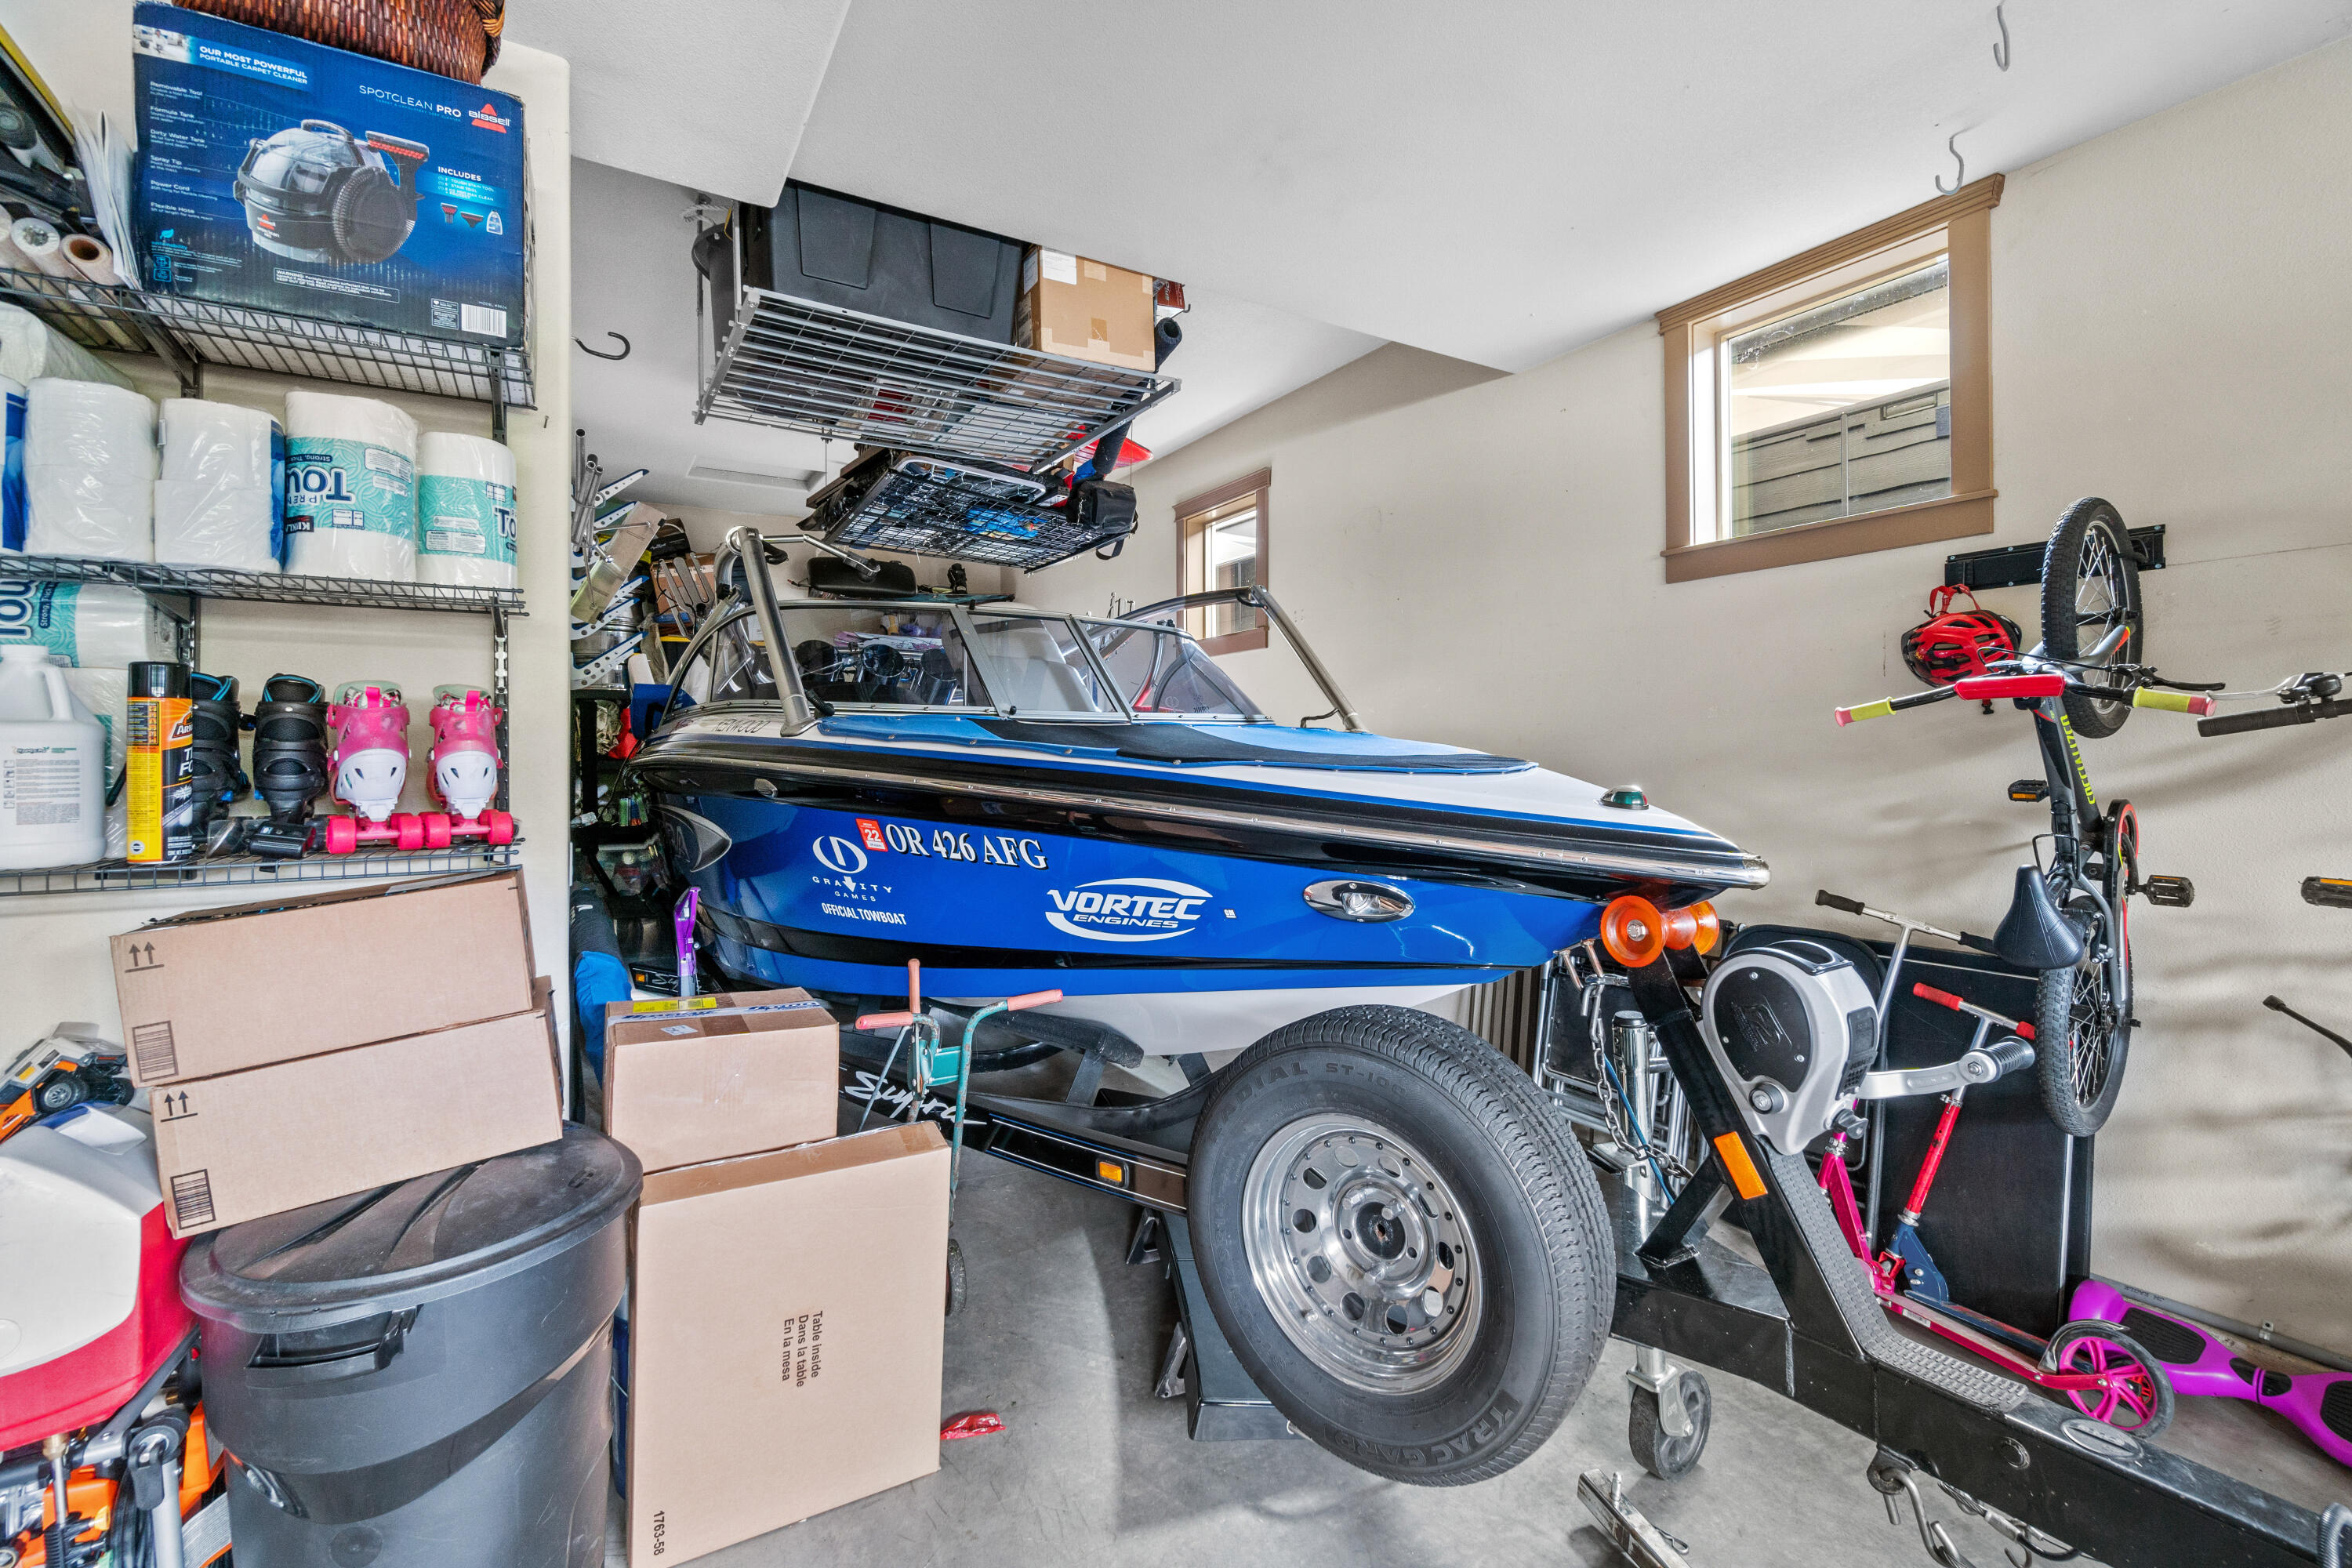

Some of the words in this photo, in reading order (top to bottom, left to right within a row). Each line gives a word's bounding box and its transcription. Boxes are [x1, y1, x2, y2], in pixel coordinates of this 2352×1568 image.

[199, 45, 222, 57] OUR
[223, 51, 252, 64] MOST
[254, 57, 307, 79] POWERFUL
[199, 53, 239, 67] PORTABLE
[241, 61, 271, 75] CARPET
[273, 71, 307, 85] CLEANER
[151, 81, 187, 93] Removable
[359, 85, 433, 111] SPOTCLEAN
[436, 104, 462, 118] PRO
[151, 106, 178, 116] Formula
[179, 111, 194, 119] Tank
[151, 129, 167, 137] Dirty
[169, 132, 188, 141] Water
[437, 166, 481, 182] INCLUDES
[151, 180, 172, 188] Power
[151, 202, 176, 211] Flexible
[276, 270, 303, 278] WARNING:
[40, 603, 50, 627] Strong,
[864, 829, 882, 842] 22
[885, 823, 931, 857] OR
[932, 829, 978, 862] 426
[982, 834, 1049, 869] AFG
[834, 891, 877, 902] GAMES
[1047, 889, 1207, 920] VORTEC
[822, 903, 859, 920] OFFICIAL
[857, 908, 906, 925] TOWBOAT
[1073, 913, 1178, 928] ENGINES
[784, 1318, 794, 1334] En
[798, 1314, 809, 1345] Dans
[812, 1310, 823, 1341] Table
[782, 1337, 793, 1348] la
[797, 1346, 808, 1358] la
[811, 1344, 822, 1378] inside
[797, 1359, 807, 1388] table
[654, 1510, 665, 1555] 1763-58
